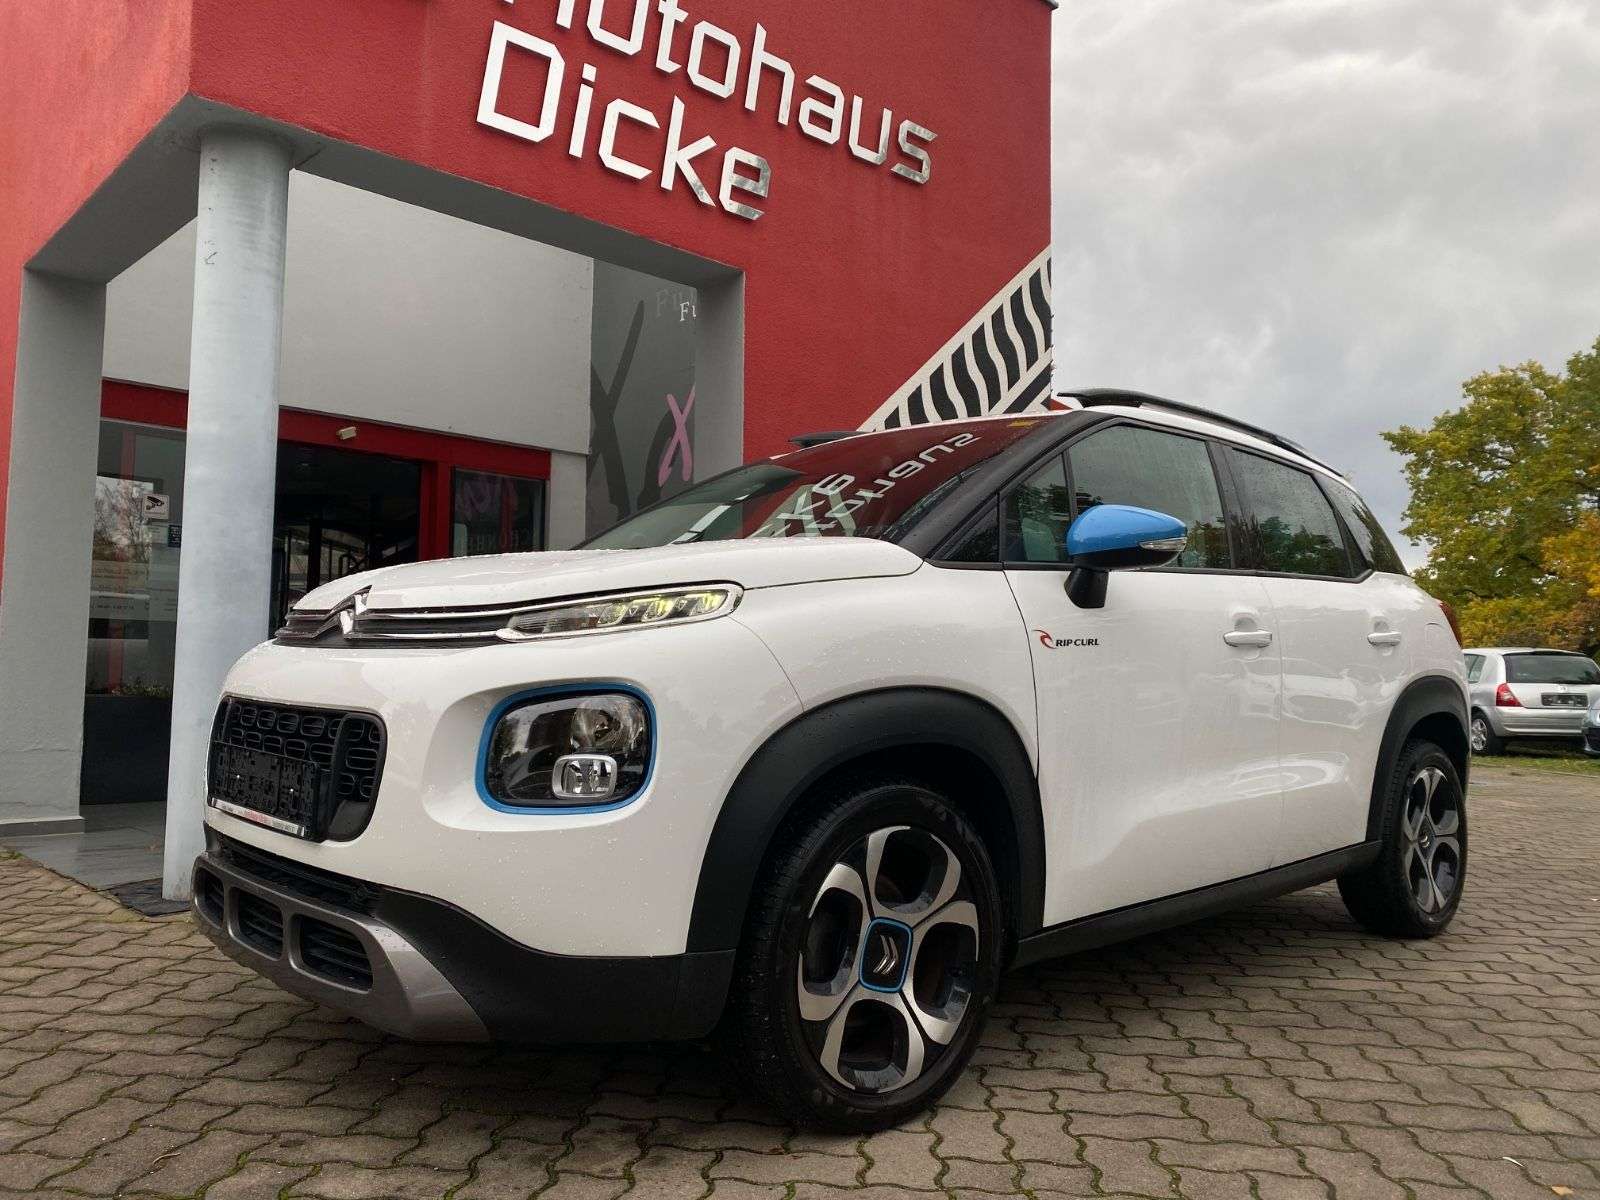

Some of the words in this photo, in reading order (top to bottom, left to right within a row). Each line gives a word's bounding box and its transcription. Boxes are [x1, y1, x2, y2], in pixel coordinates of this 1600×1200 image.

[477, 20, 771, 220] Dicke
[504, 0, 937, 184] utohaus
[1055, 639, 1073, 647] RIP
[1073, 638, 1100, 646] CURL
